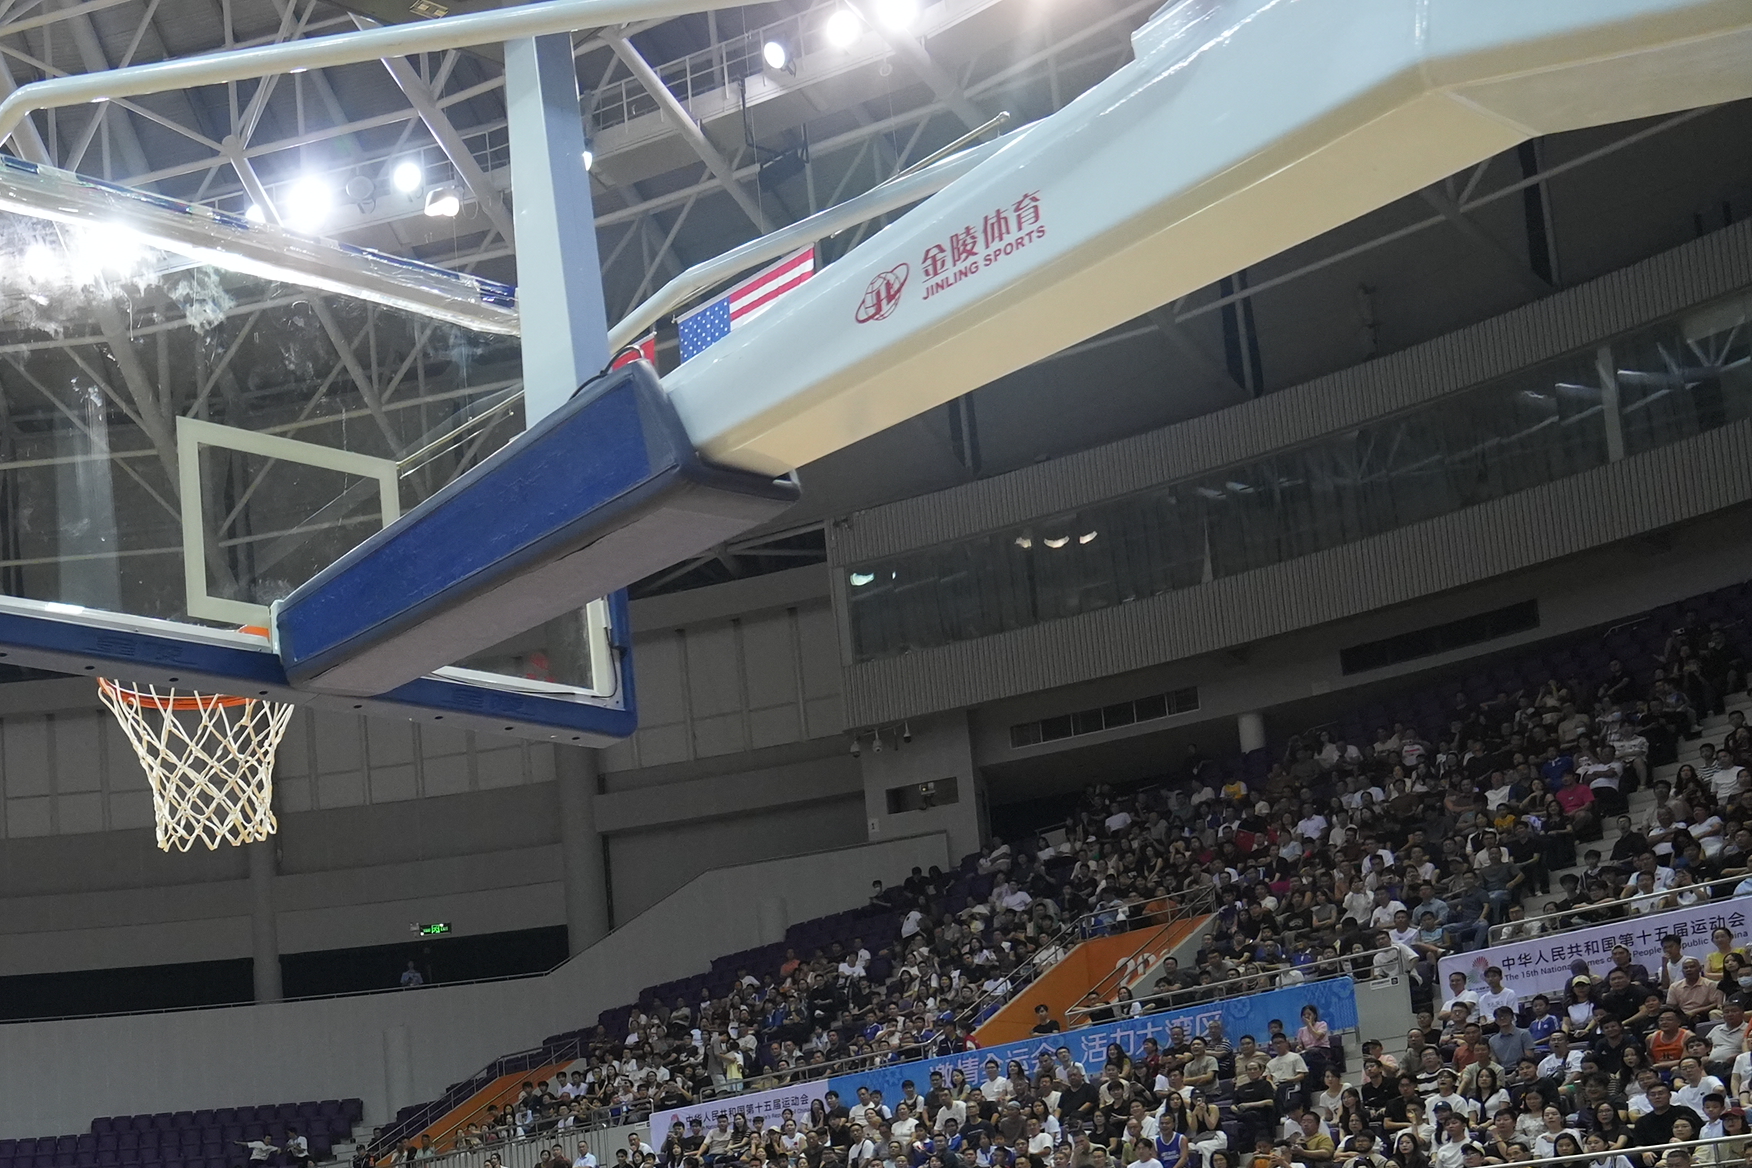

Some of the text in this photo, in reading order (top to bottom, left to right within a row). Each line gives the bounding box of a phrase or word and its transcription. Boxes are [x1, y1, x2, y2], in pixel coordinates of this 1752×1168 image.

[921, 189, 1041, 283] 金陵体育
[922, 225, 1046, 300] JINLING SPORTS
[1521, 968, 1539, 978] 15th
